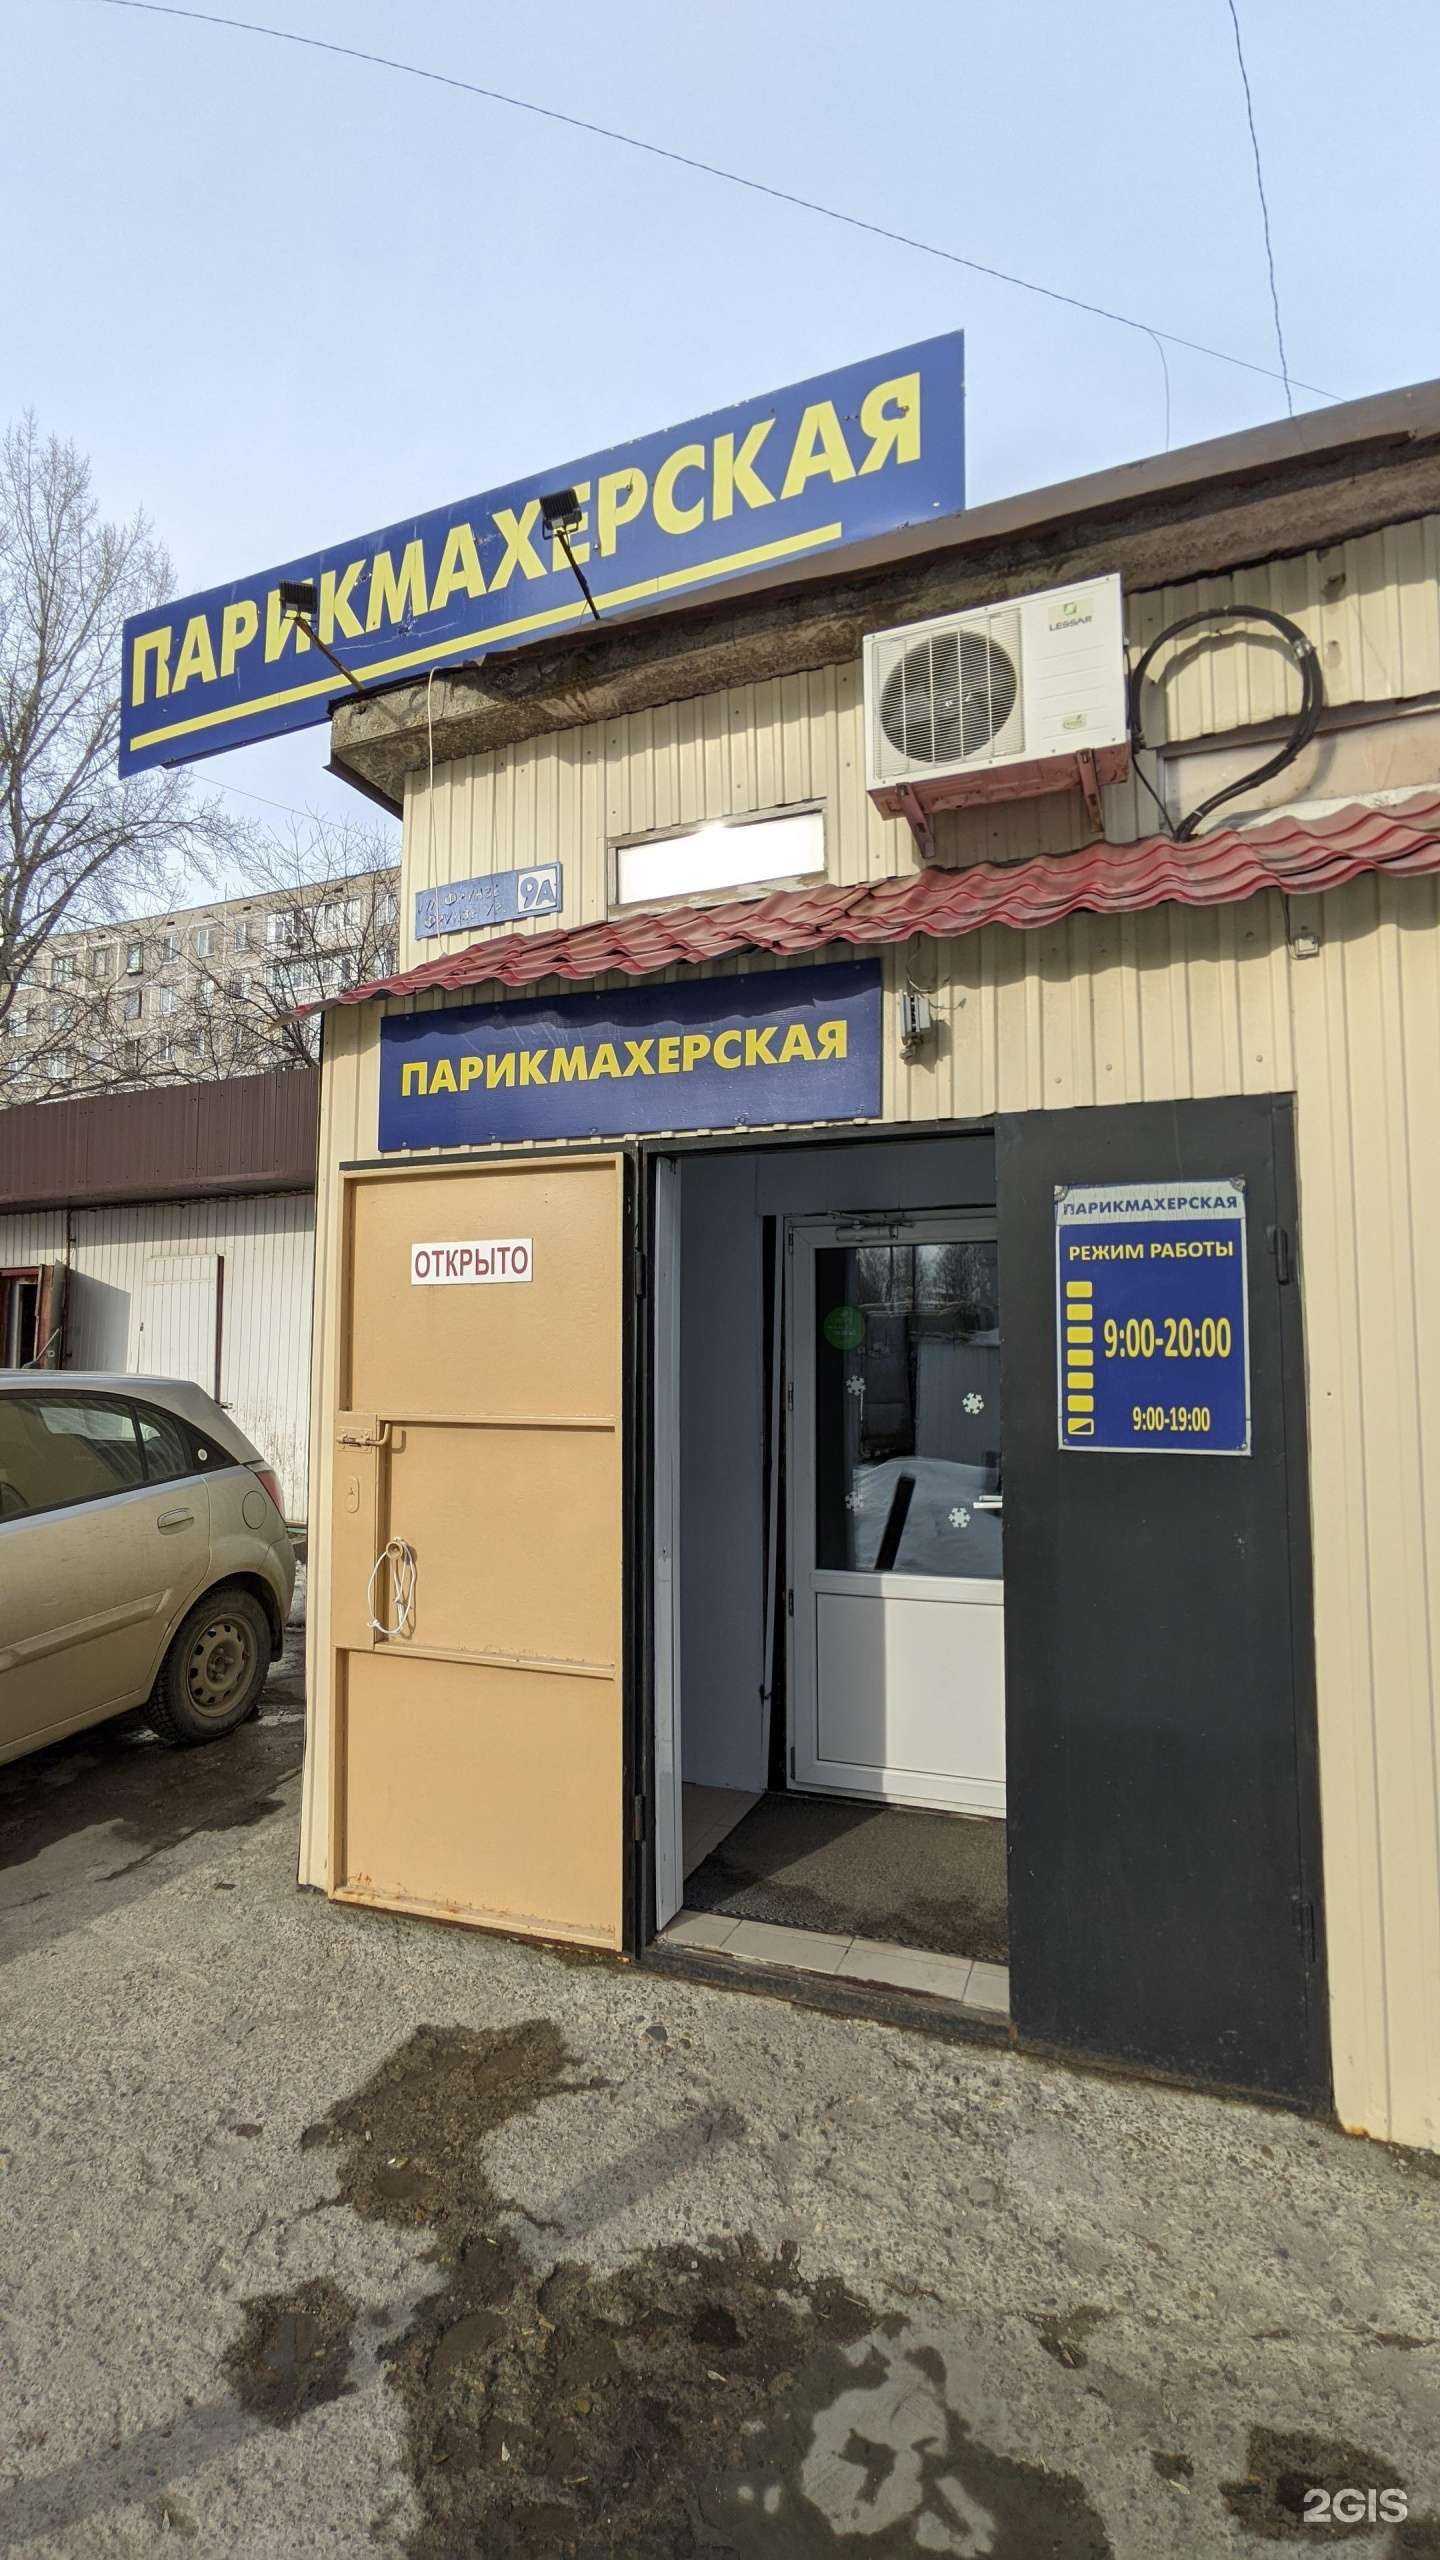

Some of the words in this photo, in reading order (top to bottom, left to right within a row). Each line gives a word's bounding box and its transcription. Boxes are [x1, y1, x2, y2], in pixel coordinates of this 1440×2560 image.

[131, 372, 922, 707] ПАРИКМАХЕРСКАЯ
[1048, 615, 1093, 632] LESSAR
[520, 876, 556, 909] 9А
[401, 1019, 849, 1097] ПАРИКМАХЕРСКАЯ
[1063, 1195, 1238, 1216] ПАРИКМАХЕРСКАЯ
[414, 1245, 529, 1279] ОТКРЫТО
[1069, 1243, 1144, 1261] РЕЖИМ
[1150, 1241, 1234, 1258] РАБОТЫ
[1103, 1316, 1232, 1359] 9:00-20:00
[1132, 1406, 1211, 1432] 9:00-19:00
